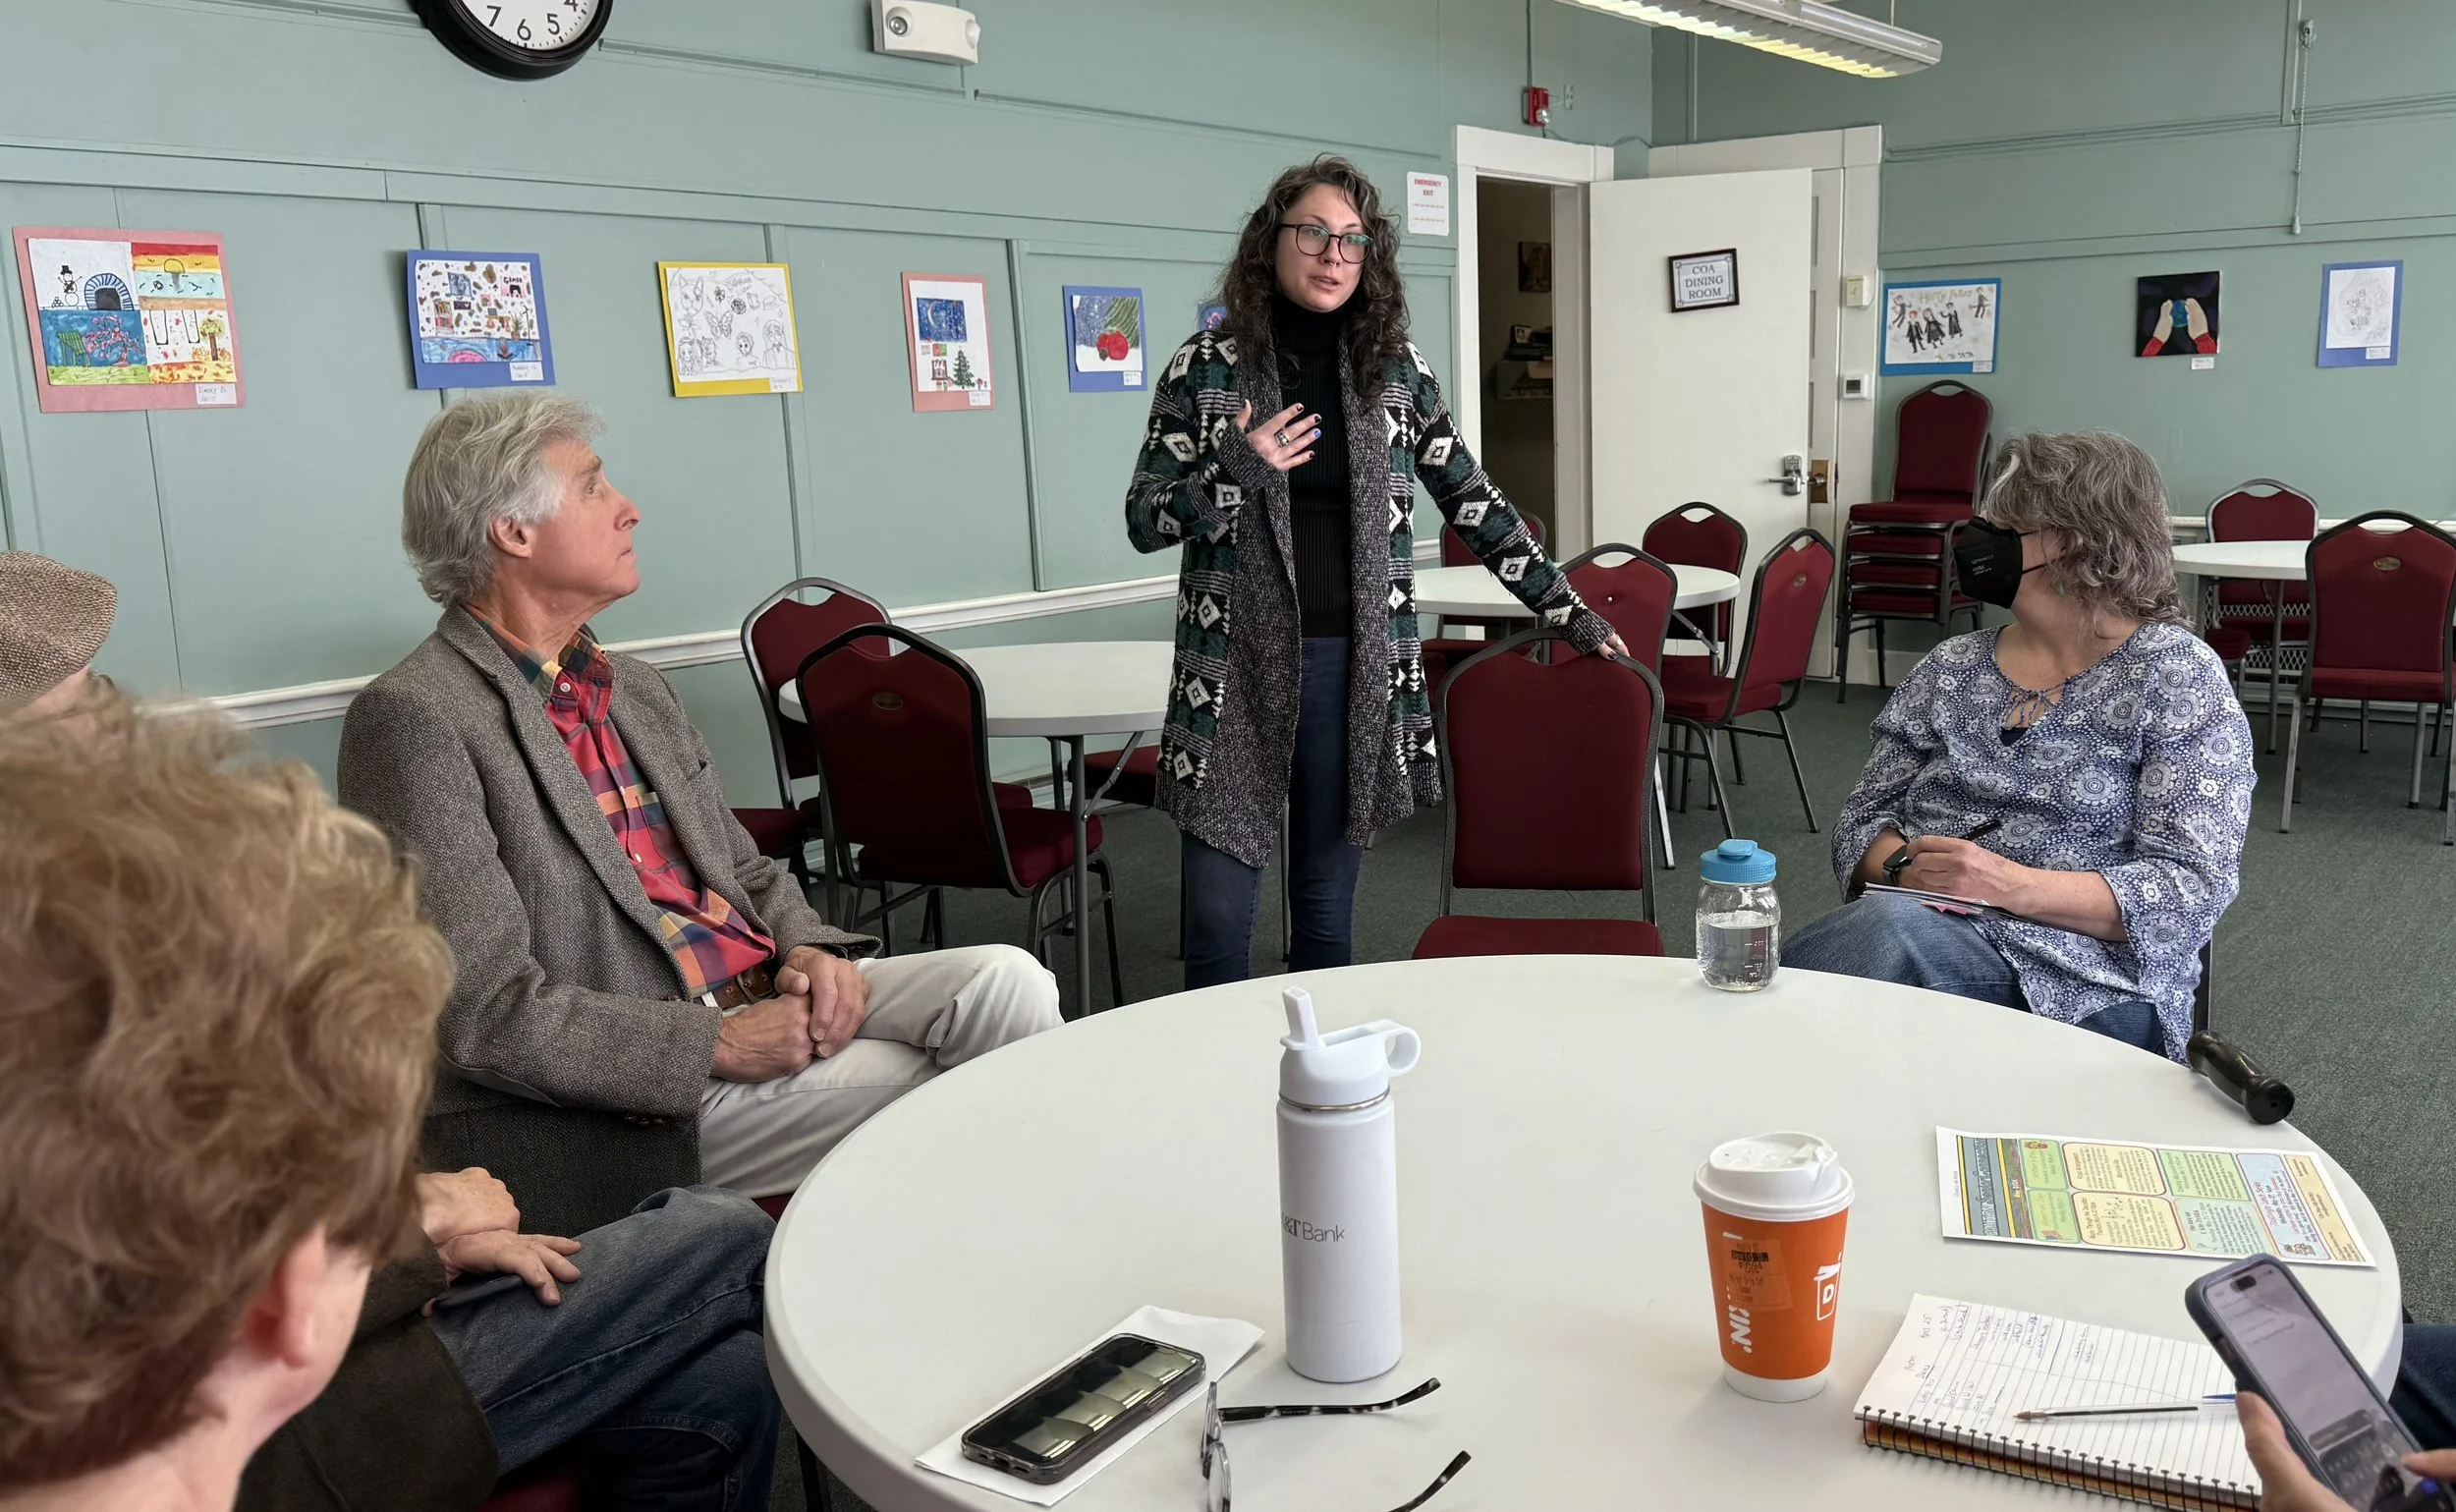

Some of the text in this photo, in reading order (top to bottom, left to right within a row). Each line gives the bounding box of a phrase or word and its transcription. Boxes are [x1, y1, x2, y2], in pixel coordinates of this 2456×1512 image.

[486, 5, 502, 28] 7
[546, 13, 561, 35] 5
[517, 19, 531, 41] 6
[1692, 264, 1715, 275] COA
[1685, 275, 1723, 288] DINING
[1688, 287, 1721, 300] ROOM
[1281, 1211, 1345, 1243] &T Bank
